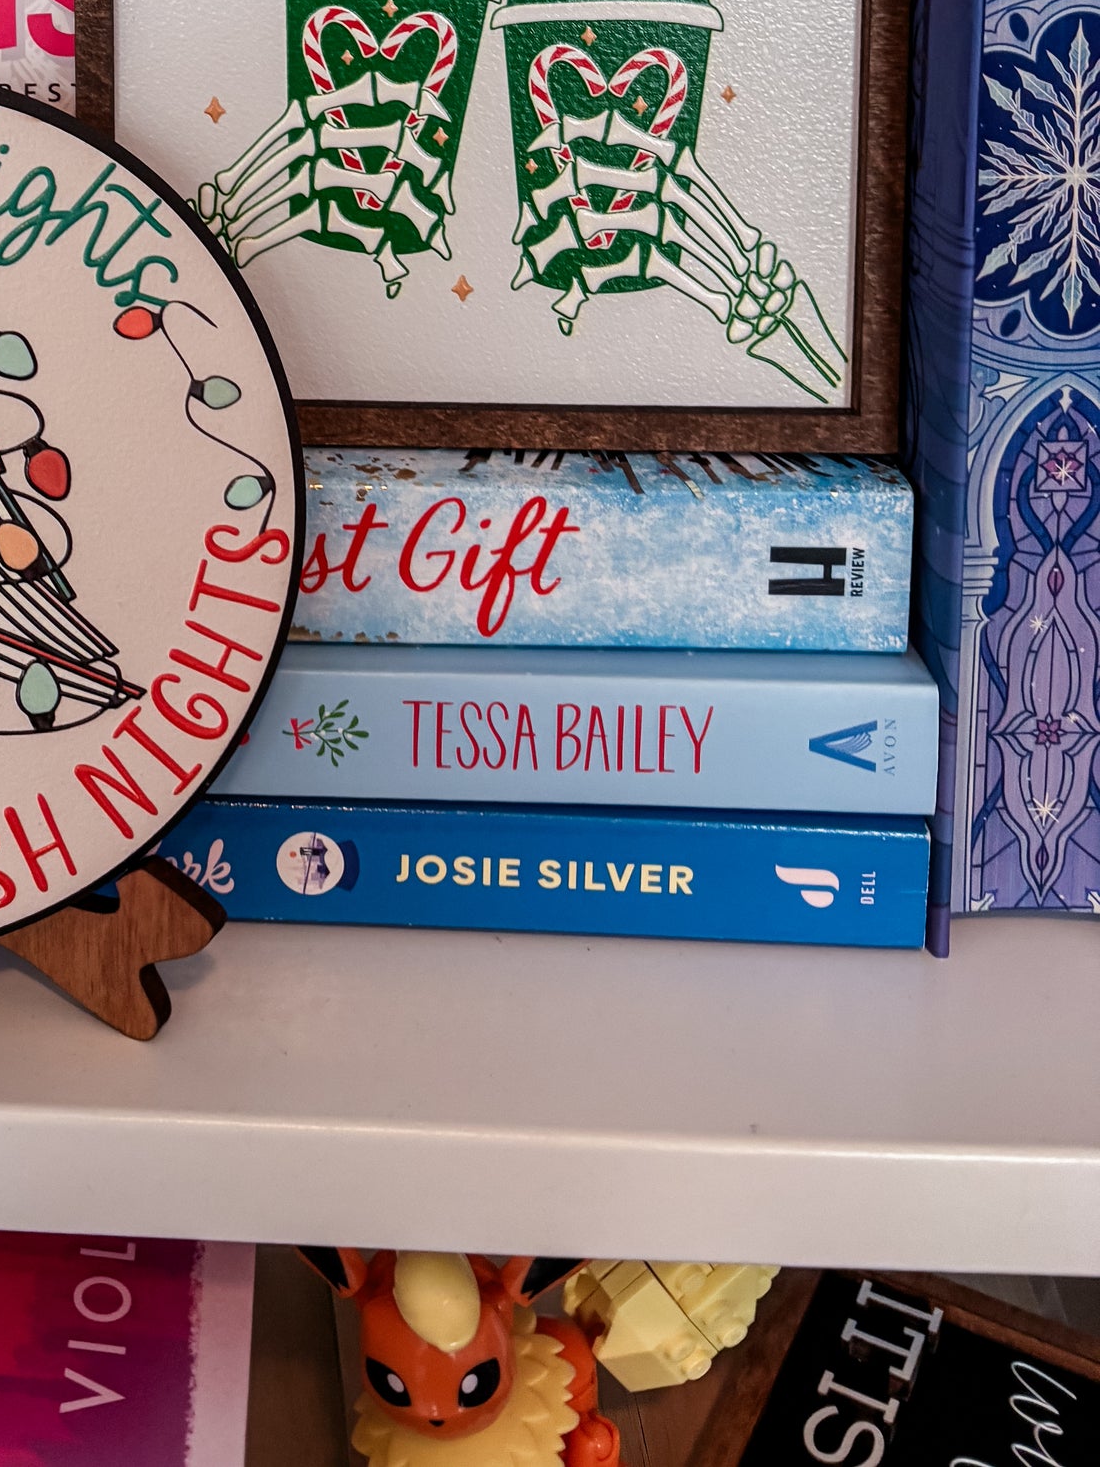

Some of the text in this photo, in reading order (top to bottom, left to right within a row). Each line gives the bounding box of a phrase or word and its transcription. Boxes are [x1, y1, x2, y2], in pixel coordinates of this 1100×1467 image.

[398, 496, 582, 638] Gift
[850, 547, 866, 598] REVIEW
[74, 523, 291, 842] NIGHTS
[403, 700, 715, 775] TESSA BAILEY
[883, 718, 897, 777] AVON
[396, 853, 695, 896] JOSIE SILVER
[860, 871, 877, 905] DELL
